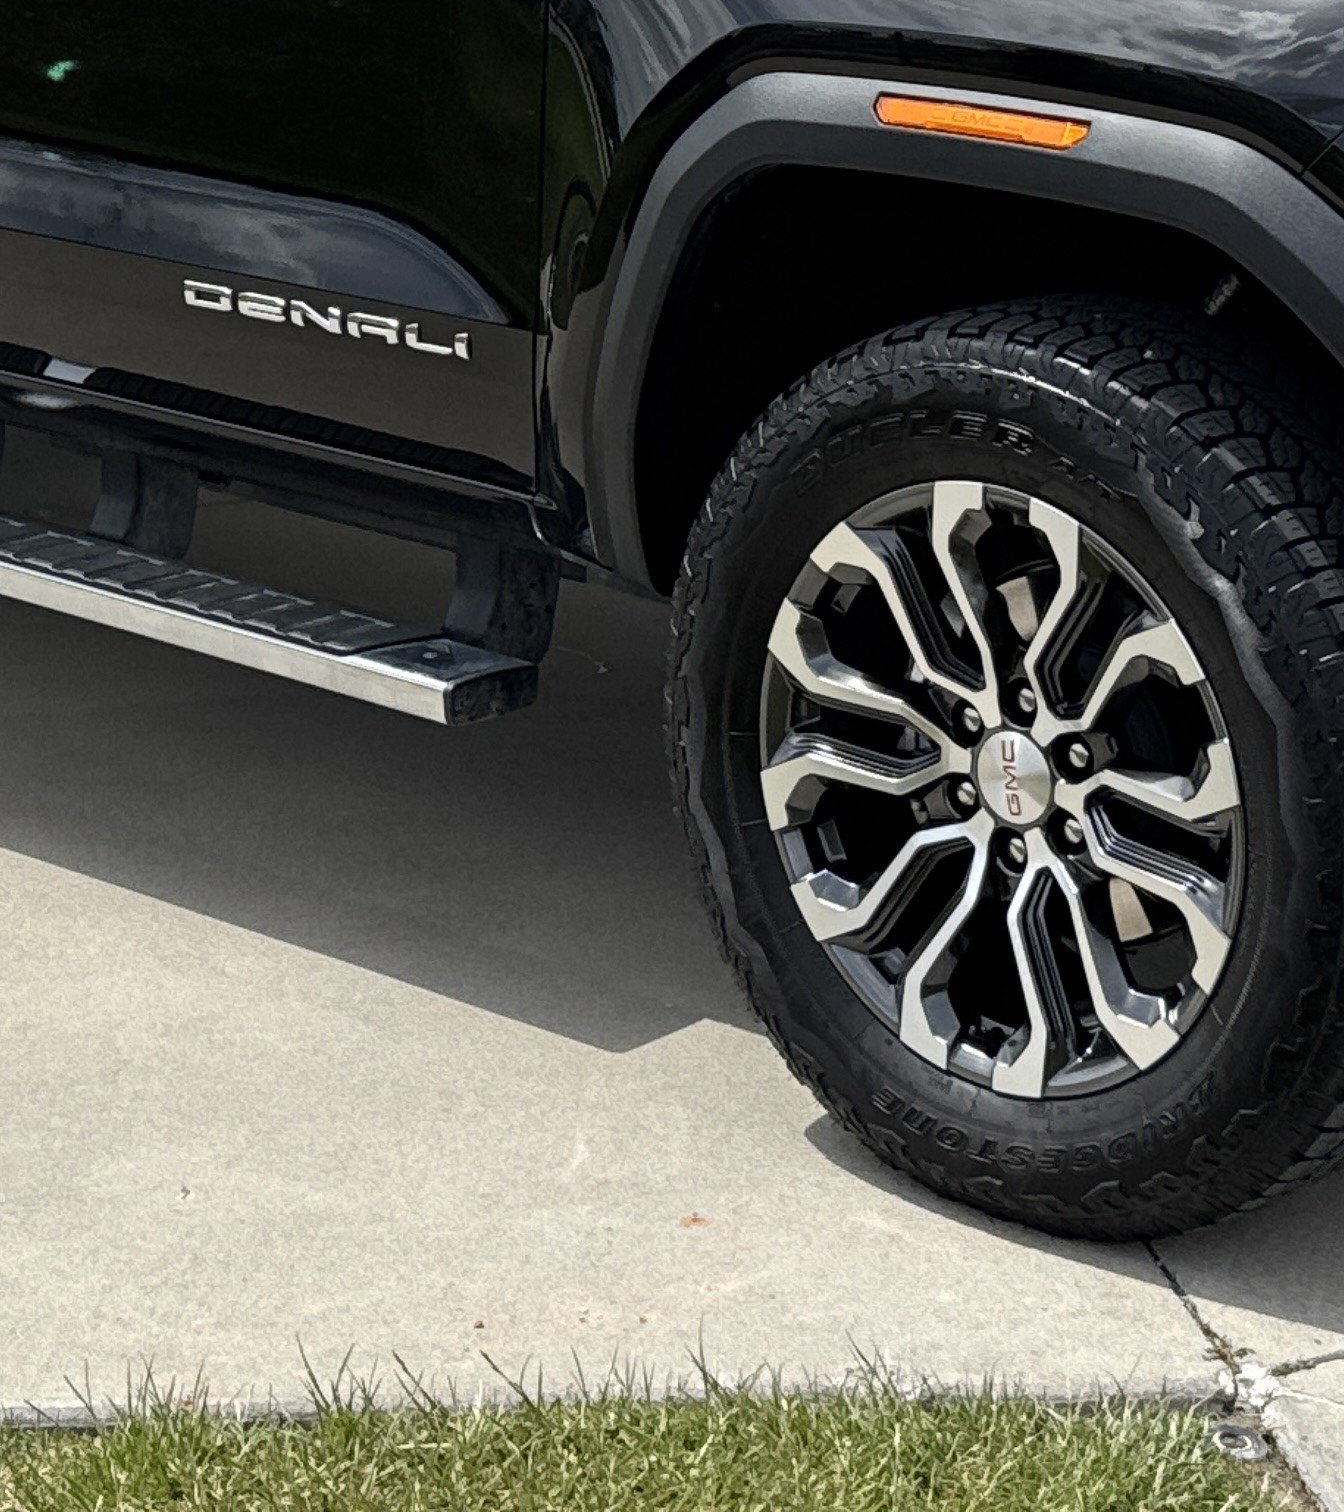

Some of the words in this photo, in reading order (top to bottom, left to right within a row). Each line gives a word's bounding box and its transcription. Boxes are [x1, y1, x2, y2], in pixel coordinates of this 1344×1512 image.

[183, 278, 472, 361] DENALI
[1000, 740, 1023, 816] GMC
[871, 1069, 1216, 1172] BRIDGESTONE
